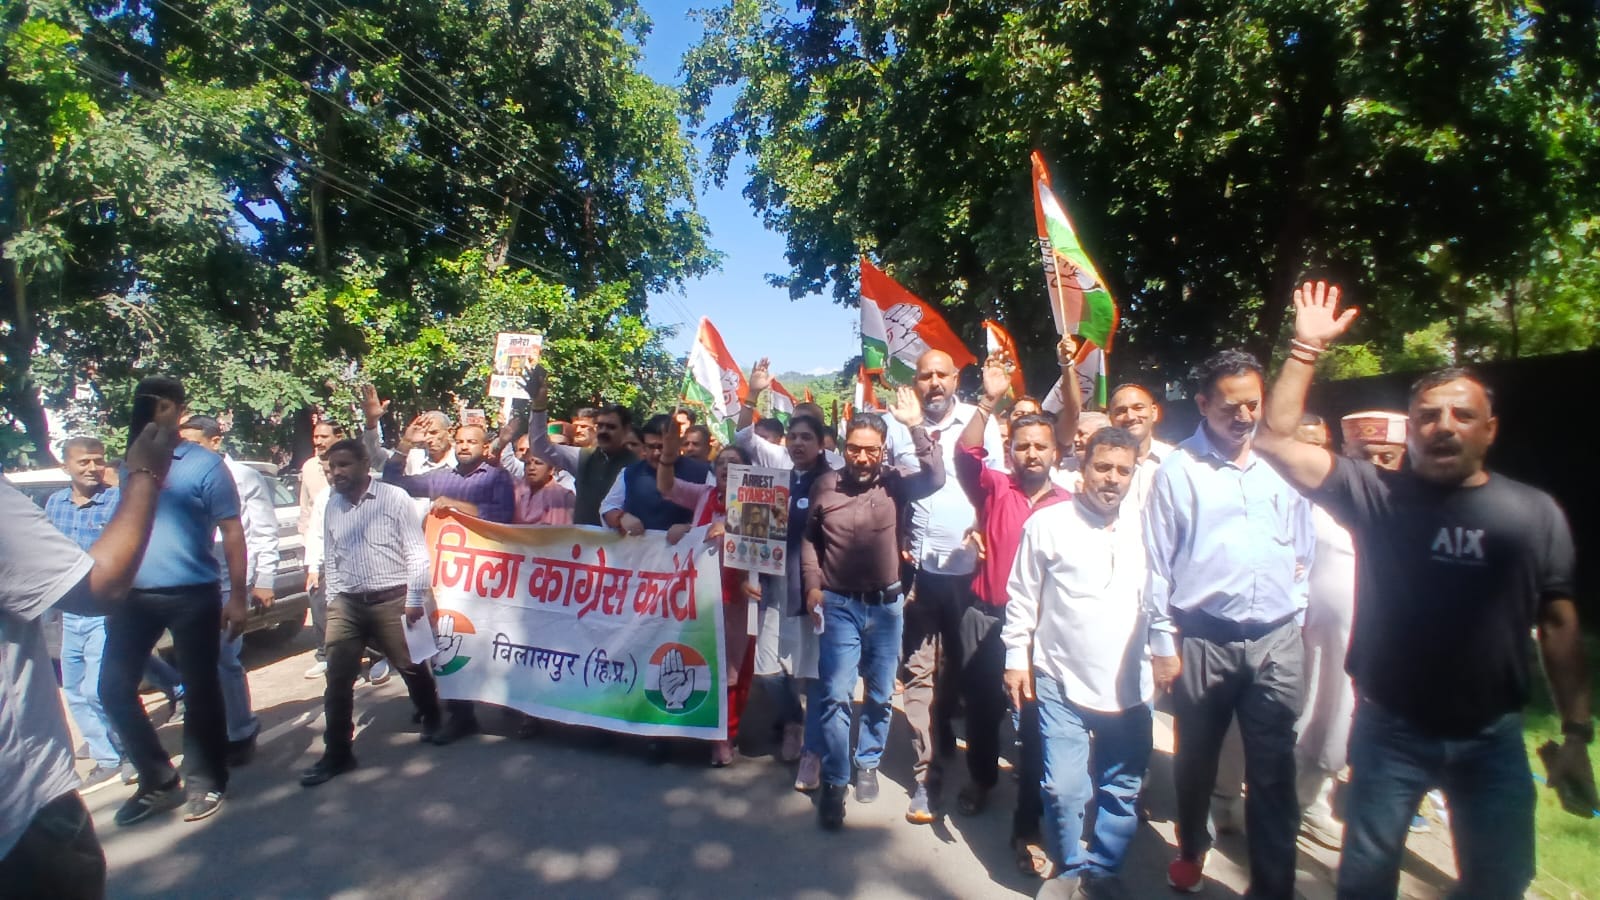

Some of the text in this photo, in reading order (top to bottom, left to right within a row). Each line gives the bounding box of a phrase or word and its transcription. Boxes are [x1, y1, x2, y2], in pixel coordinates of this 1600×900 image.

[742, 473, 774, 488] ARREST
[737, 487, 776, 504] GYANESH
[432, 524, 526, 599] जिला
[528, 544, 633, 619] कांग्रेस
